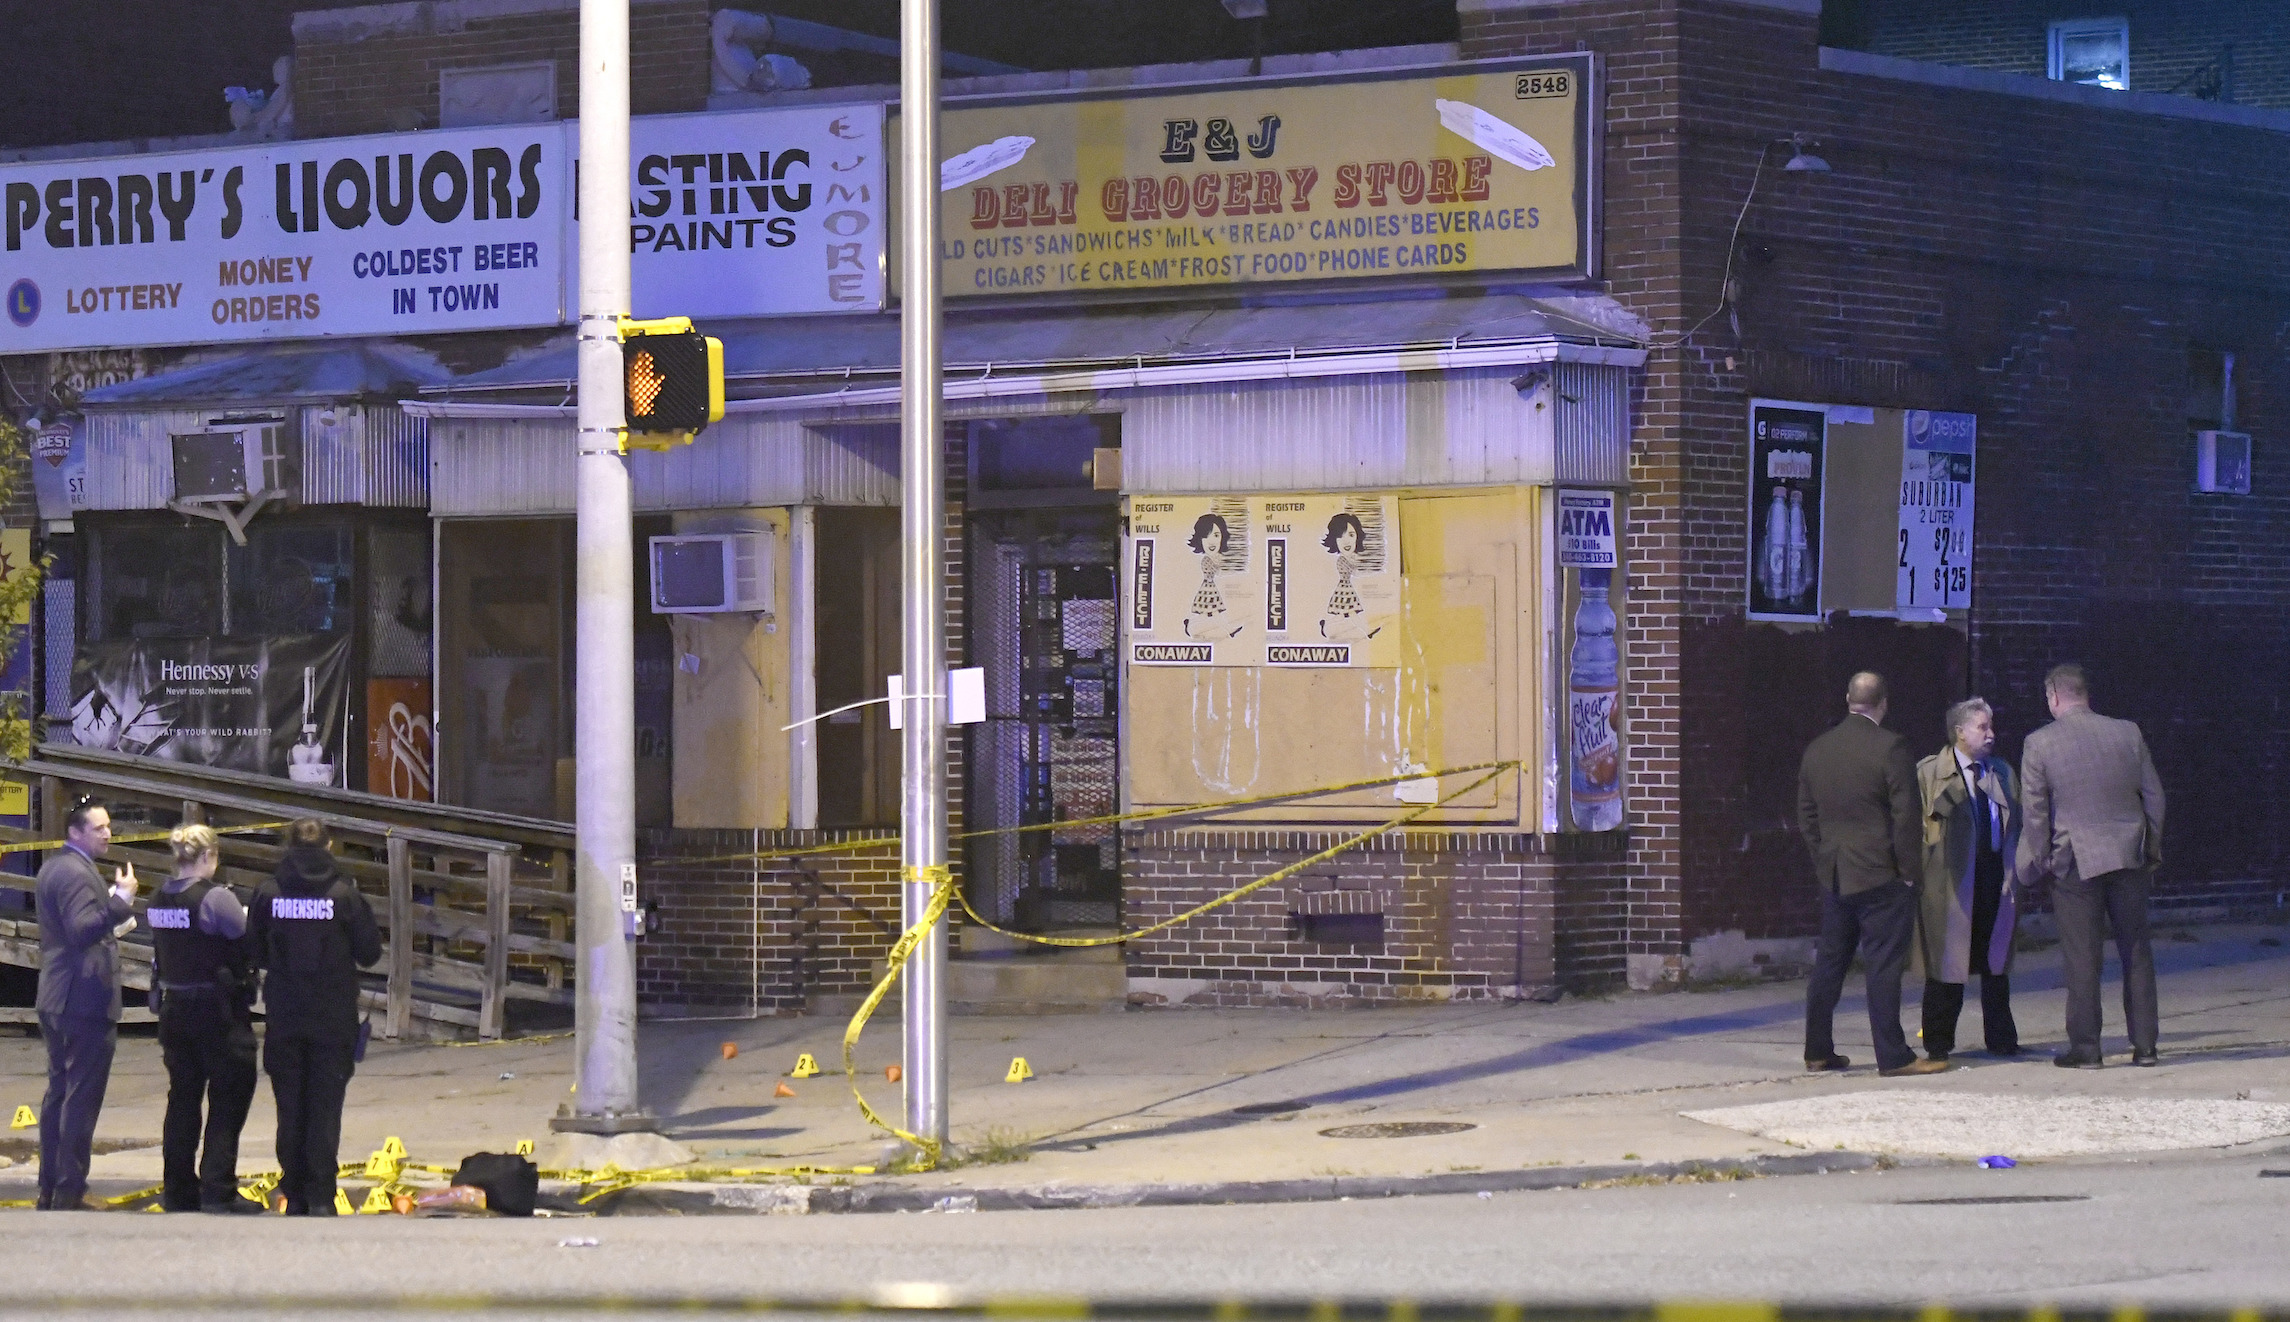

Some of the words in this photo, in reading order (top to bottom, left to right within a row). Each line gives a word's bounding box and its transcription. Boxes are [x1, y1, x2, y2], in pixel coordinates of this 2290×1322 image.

[1518, 76, 1567, 97] 2548
[1159, 113, 1281, 163] E&J
[574, 148, 812, 221] STING
[970, 181, 1077, 229] DELI
[1101, 168, 1317, 223] GROCERY
[1333, 154, 1492, 208] STORE
[6, 166, 243, 251] PERRY'S
[275, 143, 542, 233] LIQUORS
[630, 217, 796, 253] PAINTS
[974, 235, 1024, 259] CUTS
[1036, 229, 1152, 254] SANDWICHS
[1229, 220, 1295, 244] BREAD
[1309, 216, 1400, 240] CANDIES
[1411, 208, 1539, 236] BEVERAGES
[219, 256, 313, 286] MONEY
[353, 246, 463, 279] COLDEST
[475, 241, 538, 270] BEER
[975, 261, 1045, 288] CIGARS
[1060, 261, 1091, 281] ICE
[1099, 257, 1168, 280] CREAM
[1180, 254, 1244, 276] FROST
[1253, 250, 1307, 273] FOOD
[1318, 246, 1390, 270] PHONE
[1396, 242, 1466, 266] CARDS
[16, 291, 31, 313] L
[67, 283, 182, 314] LOTTERY
[212, 293, 320, 324] ORDERS
[393, 288, 416, 314] IN
[428, 283, 499, 312] TOWN
[38, 436, 71, 449] BEST
[1902, 481, 1961, 508] SUBURBAN
[1135, 503, 1174, 512] REGISTER
[1266, 503, 1305, 512] REGISTER
[1920, 510, 1925, 523] 2
[1930, 510, 1954, 524] LITER
[1135, 525, 1160, 533] WILLS
[1266, 524, 1291, 533] WILLS
[1561, 510, 1610, 536] ATM
[1900, 529, 1908, 567] 2
[1138, 546, 1150, 626] RE-ELECT
[1271, 546, 1282, 627] RE-ELECT
[1136, 647, 1210, 660] CONAWAY
[1270, 649, 1348, 662] CONAWAY
[161, 660, 234, 684] Hennessy
[166, 687, 186, 695] Never
[189, 687, 206, 697] stop.
[208, 687, 229, 695] Never
[185, 728, 207, 736] YOUR
[210, 728, 233, 736] WILD
[272, 898, 334, 920] FORENSICS
[799, 1058, 806, 1070] 2
[386, 1143, 393, 1154] 4
[519, 1144, 527, 1155] A
[373, 1158, 379, 1169] 7
